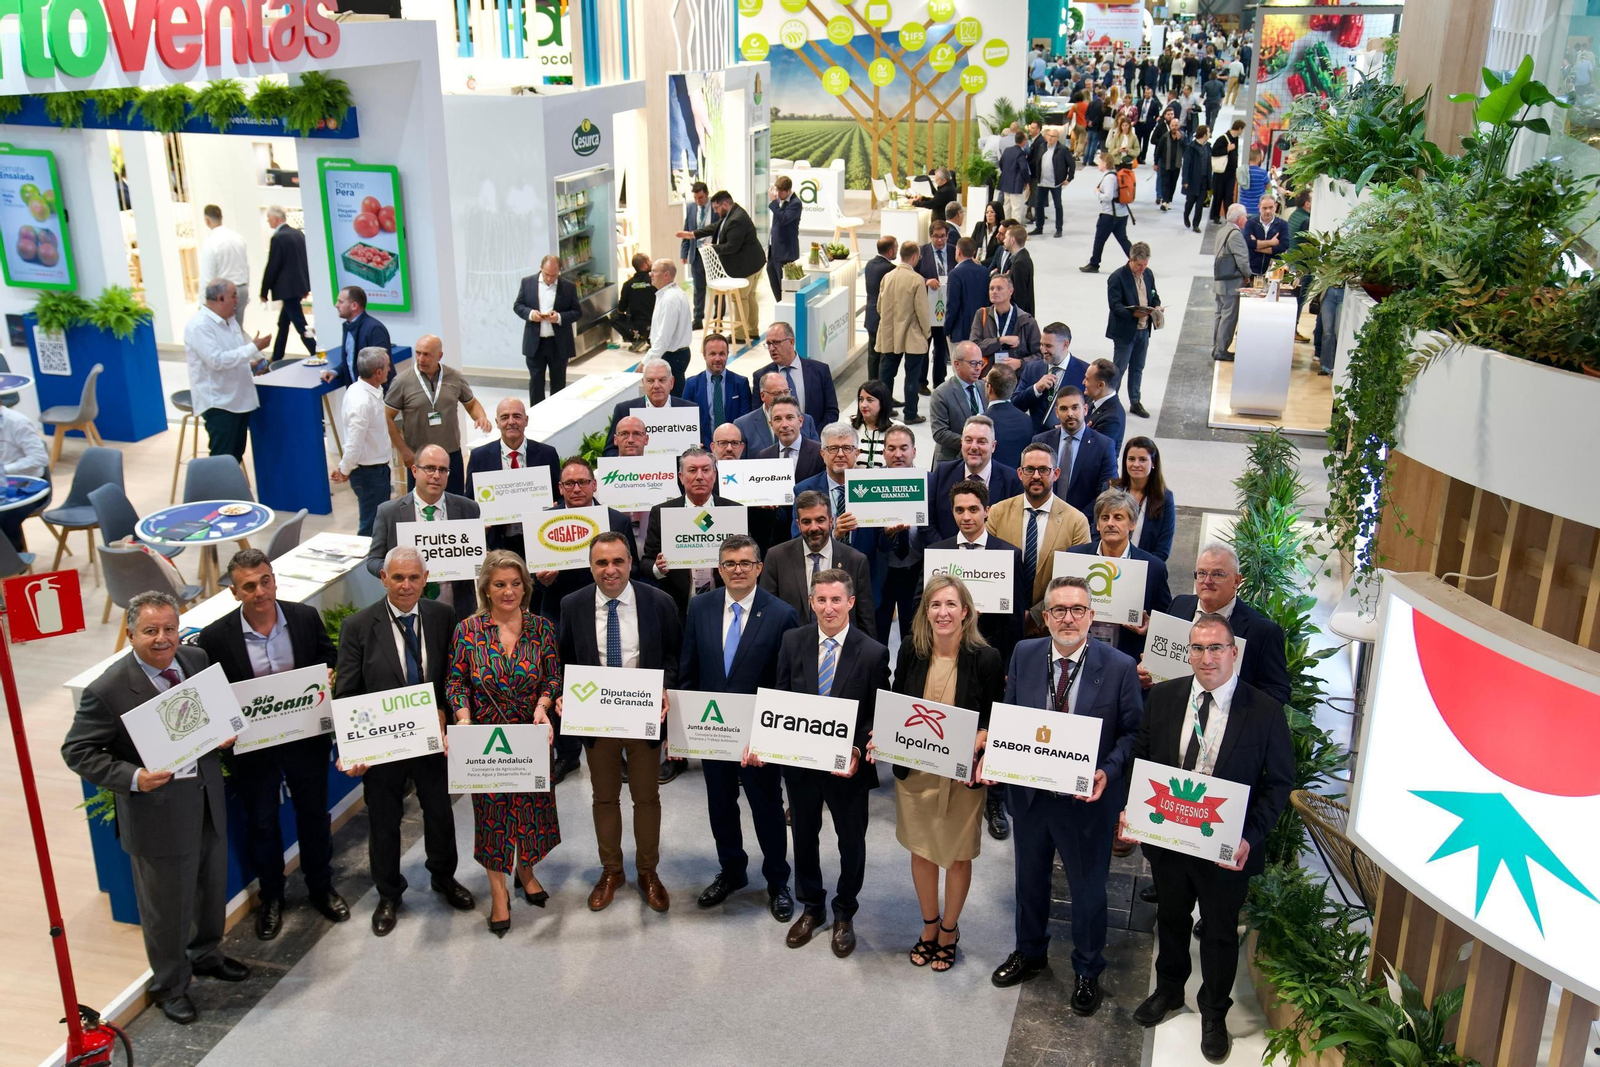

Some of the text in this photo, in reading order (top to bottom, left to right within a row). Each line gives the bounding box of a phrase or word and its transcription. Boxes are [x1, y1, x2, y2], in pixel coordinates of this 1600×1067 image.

[0, 0, 339, 79] rtoventas
[573, 133, 600, 150] Cesurca
[335, 180, 364, 189] Tomate
[335, 188, 355, 196] Pera
[646, 424, 698, 434] operativas
[601, 469, 674, 486] Hortoventas
[749, 474, 792, 483] AgroBank
[495, 481, 534, 490] cooperativas
[415, 534, 469, 546] Fruits &
[547, 525, 589, 543] COSAFRA
[675, 534, 715, 543] CENTRO
[421, 546, 483, 562] getables
[1170, 651, 1181, 661] DE
[601, 688, 651, 698] Diputación
[252, 695, 274, 706] Bio
[614, 698, 654, 707] Granada
[250, 706, 313, 723] ORGANIC REFERENCE
[347, 721, 415, 740] EL GRUPO
[761, 710, 848, 738] Granada
[895, 732, 950, 755] lapalma
[992, 740, 1090, 763] SABOR GRANADA
[1160, 798, 1209, 819] LOS FRESNOS
